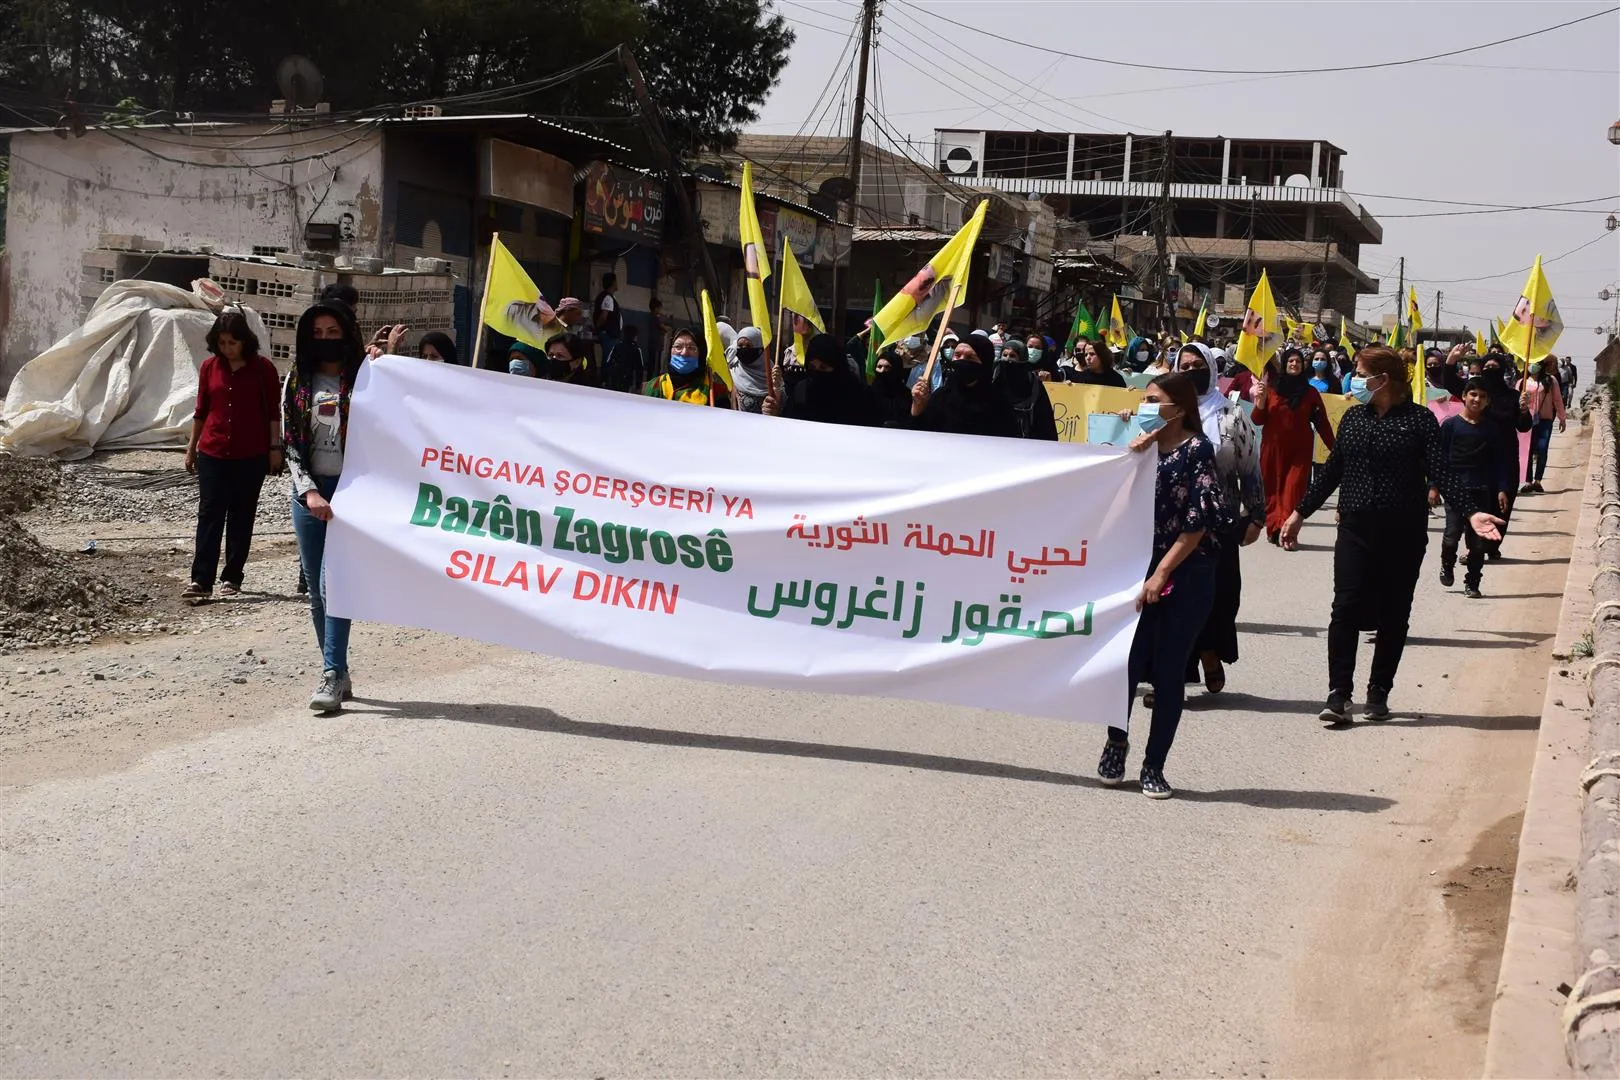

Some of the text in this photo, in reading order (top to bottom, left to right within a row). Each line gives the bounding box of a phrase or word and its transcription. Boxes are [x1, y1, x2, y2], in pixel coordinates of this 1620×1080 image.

[644, 203, 663, 225] فرن
[1053, 402, 1081, 442] Bijî
[421, 446, 755, 521] PÊNGAVA ŞOERŞGERÎ YA
[410, 482, 734, 574] Bazên Zagrosê
[786, 512, 1089, 584] نحيي الحملة الثورية
[445, 550, 681, 617] SILAV DIKIN
[746, 575, 1096, 647] لصقور زاغروس
